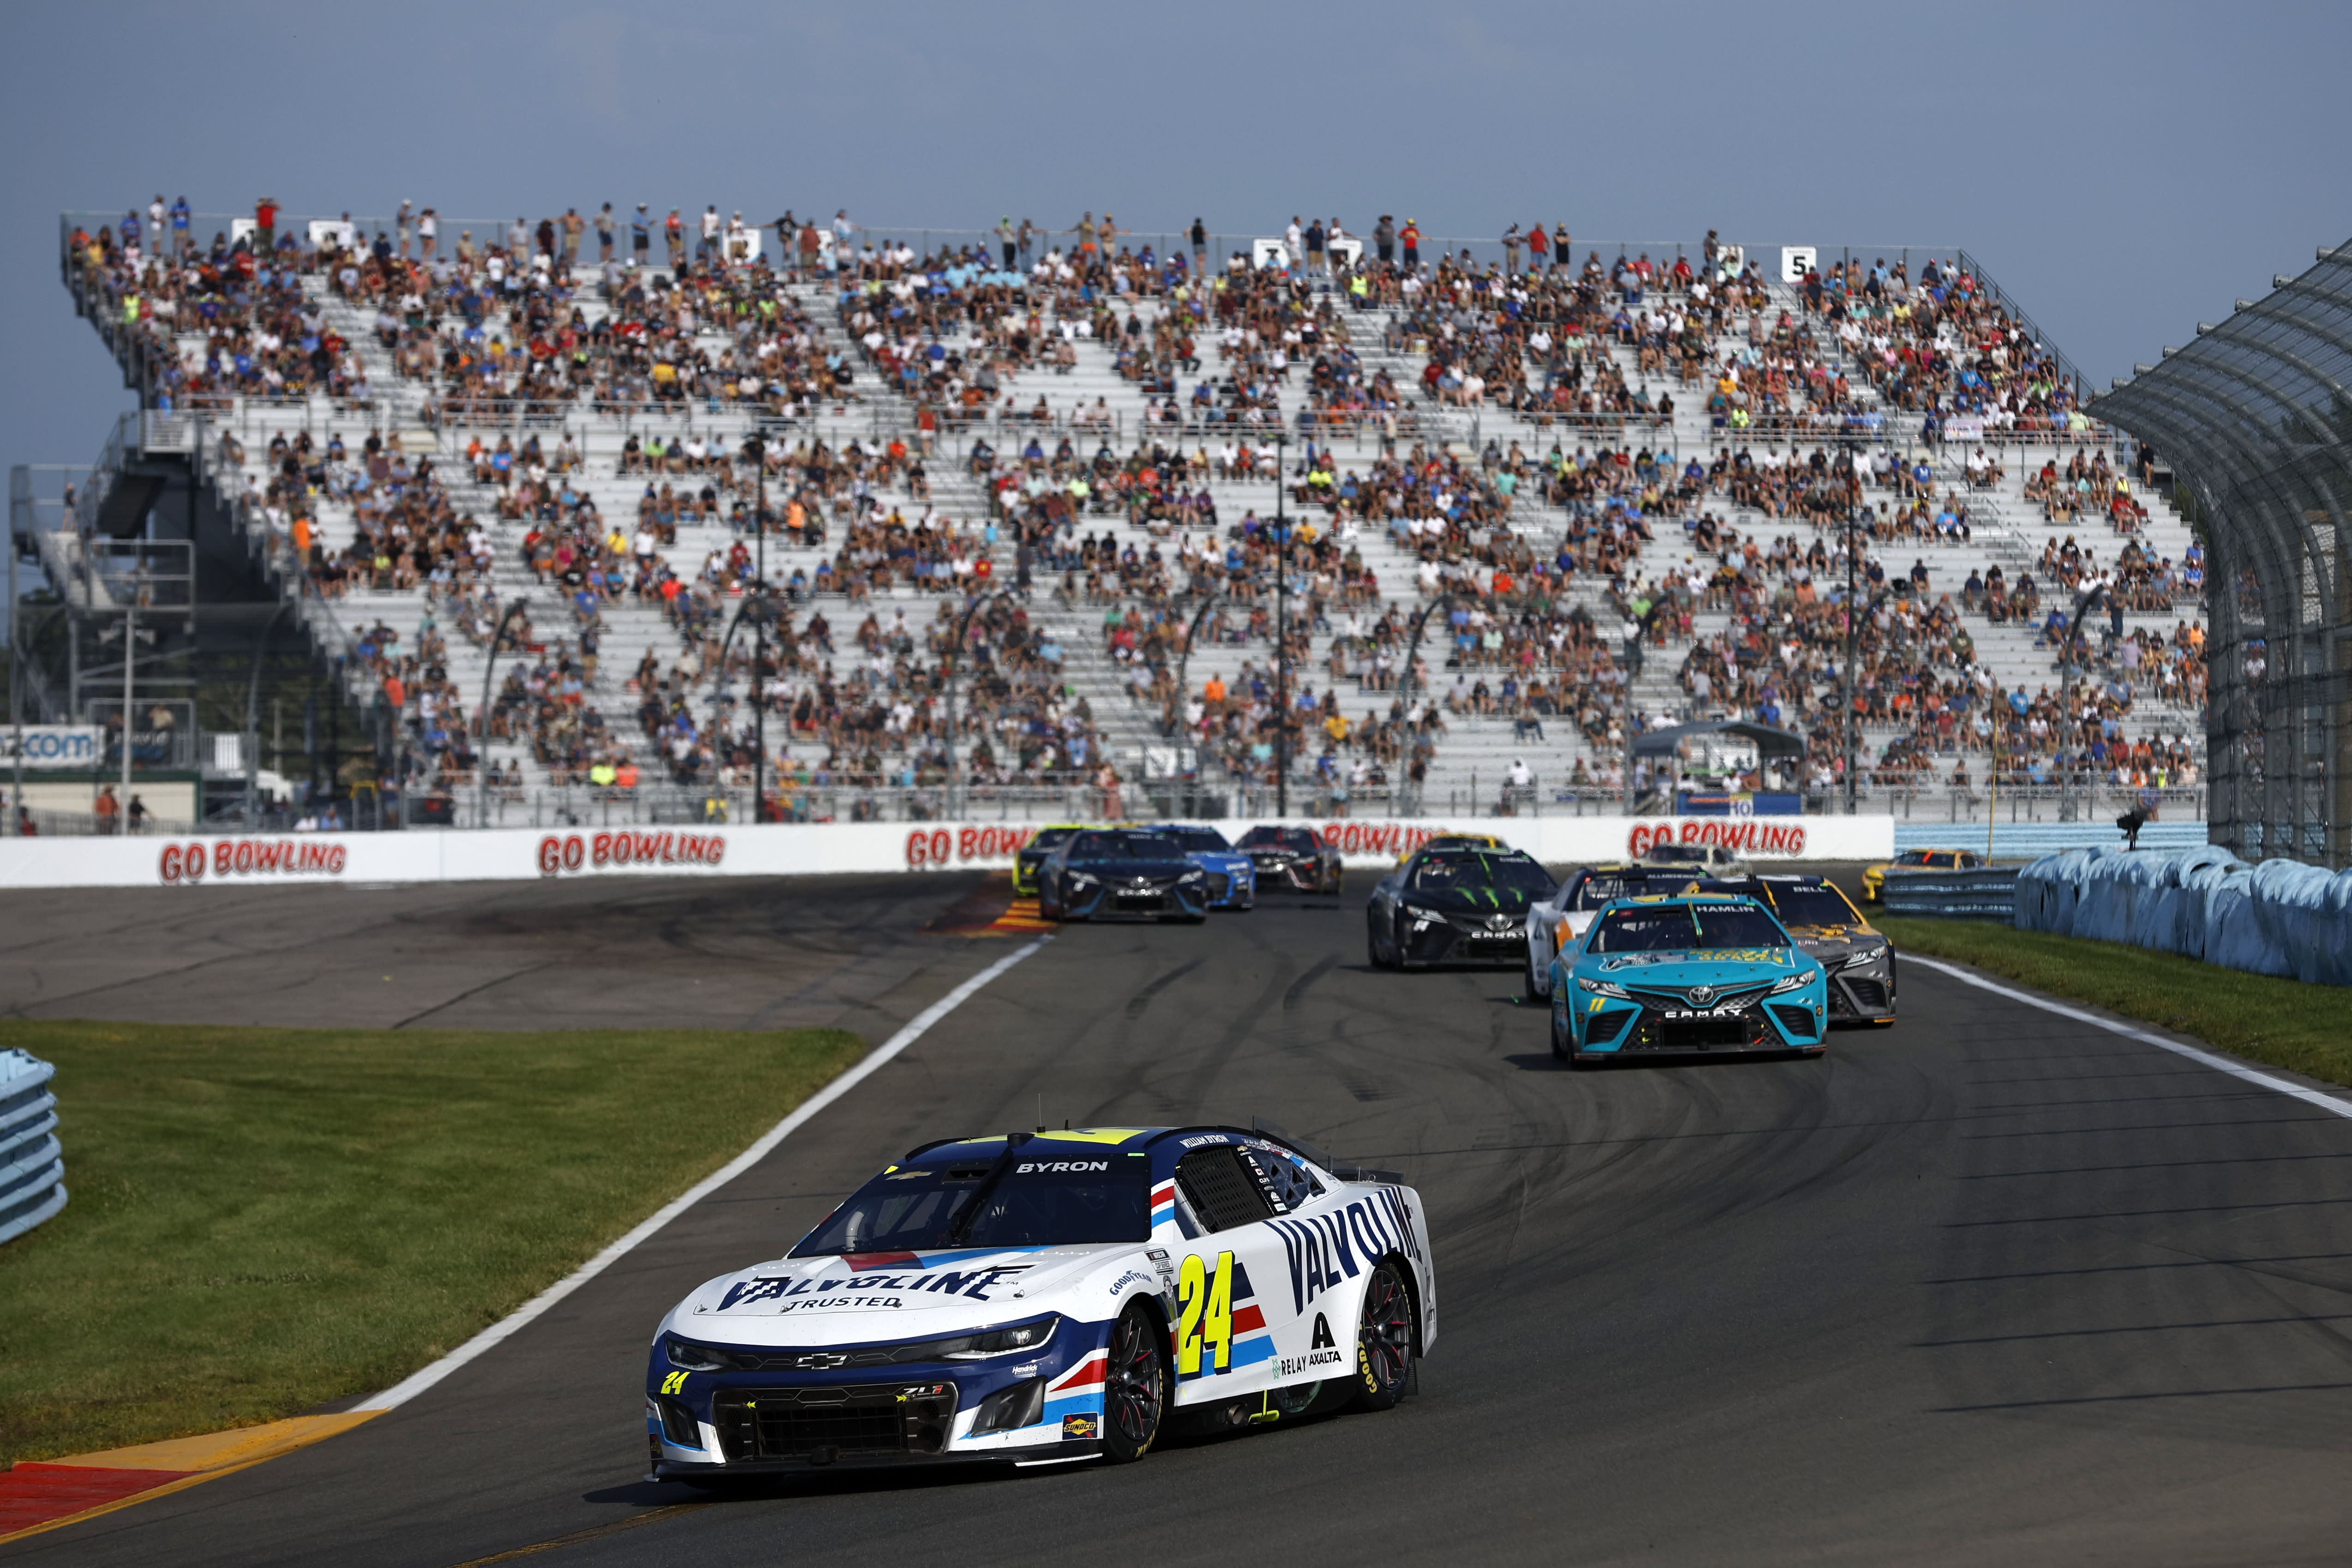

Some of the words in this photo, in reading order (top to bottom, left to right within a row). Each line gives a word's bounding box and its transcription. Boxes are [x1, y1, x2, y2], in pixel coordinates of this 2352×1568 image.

[1793, 256, 1806, 275] 5
[907, 829, 951, 866] GO
[960, 826, 1038, 859] BOW
[1324, 823, 1447, 855] BOWLIN
[1630, 822, 1672, 859] GO
[1681, 821, 1804, 854] BOWLING
[162, 844, 205, 880] GO
[215, 841, 346, 873] BOWLING
[540, 836, 584, 873] GO
[593, 832, 724, 864] BOWLING
[1588, 998, 1607, 1012] 11
[1665, 1009, 1742, 1018] CAMRY
[1179, 1135, 1207, 1148] WILLIAM
[1204, 1134, 1229, 1144] BYRON
[1016, 1161, 1108, 1173] BYRON
[1262, 1185, 1423, 1317] VALVOLINE
[716, 1270, 1023, 1312] VALVOLINE
[789, 1297, 901, 1310] TRUSTED
[1178, 1250, 1234, 1377] 24
[1012, 1364, 1037, 1375] Hendrick
[1281, 1356, 1306, 1376] RELAY
[1309, 1351, 1342, 1366] AXALTA
[660, 1371, 691, 1394] 24
[903, 1385, 943, 1396] ZL1
[1065, 1423, 1095, 1431] SUNOCO
